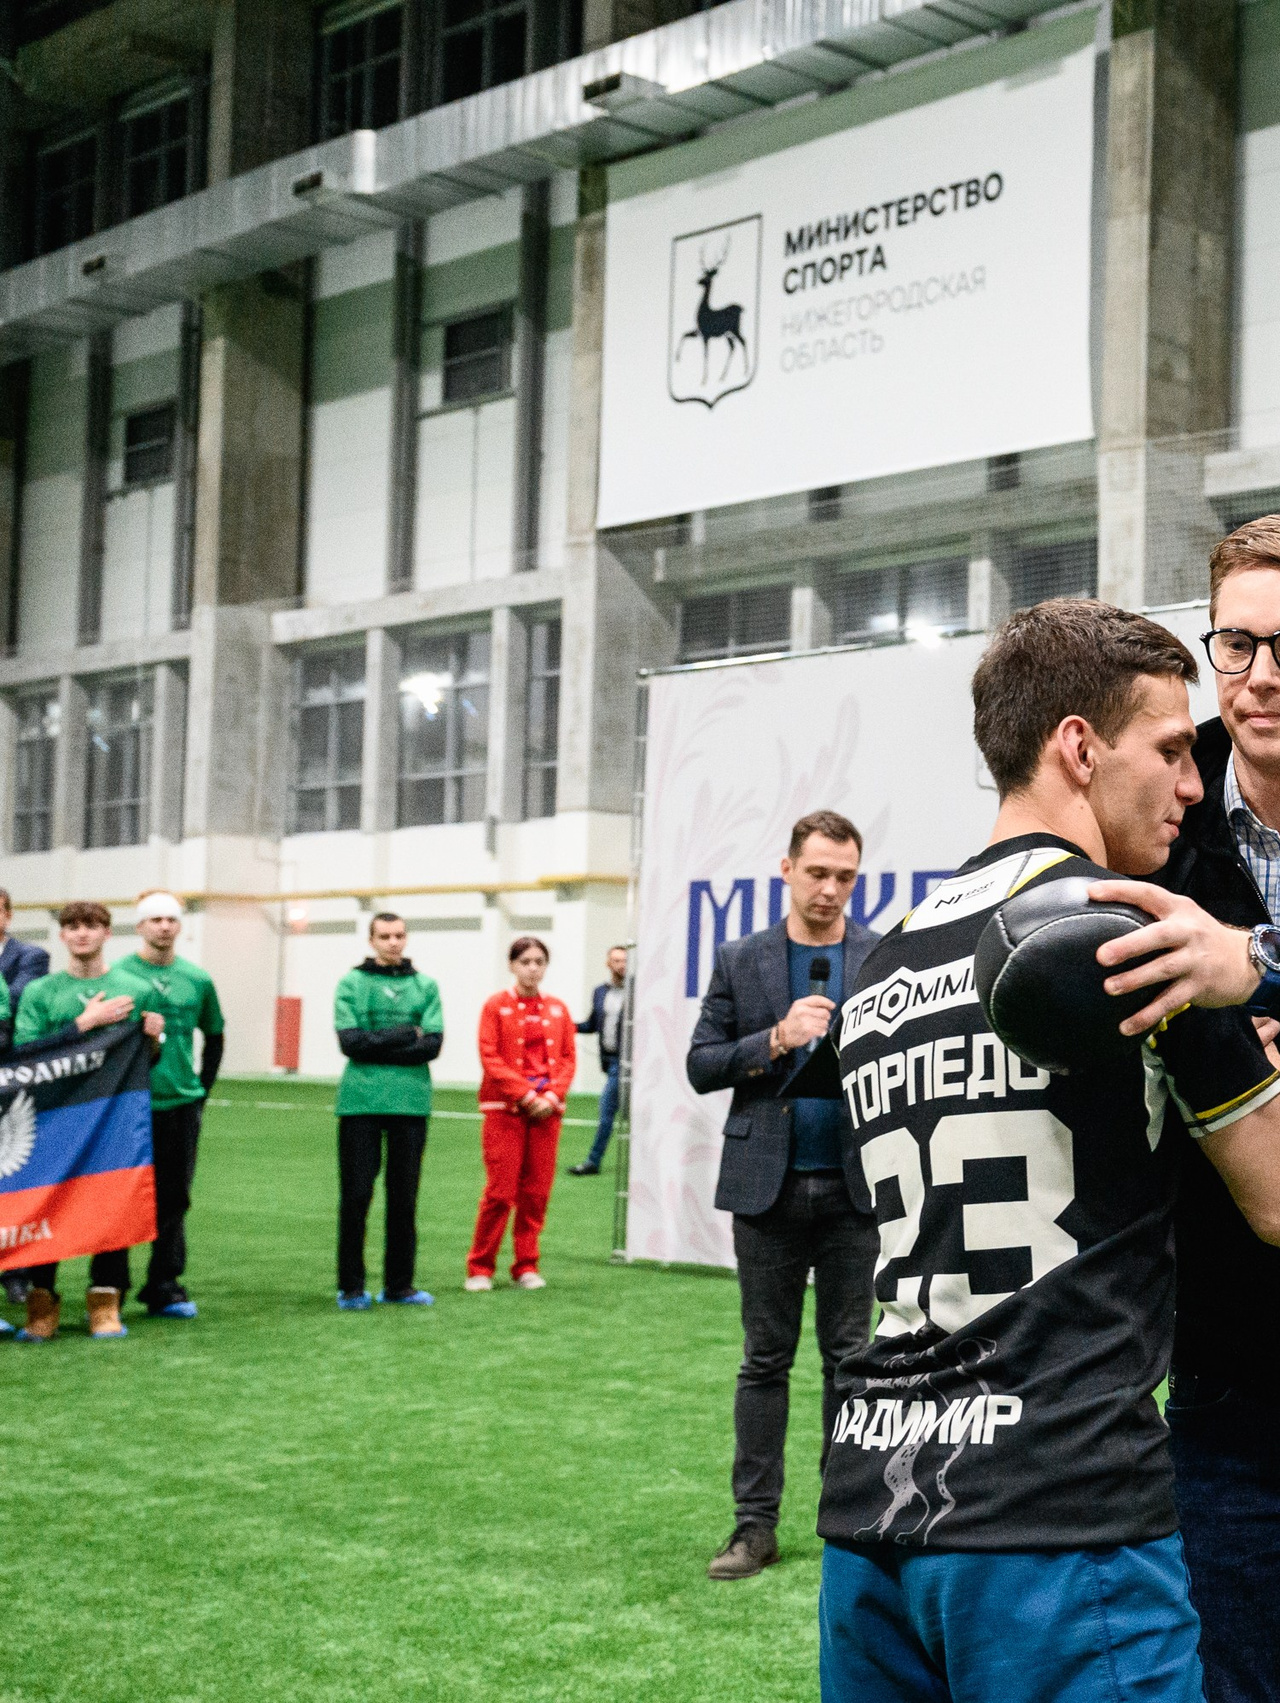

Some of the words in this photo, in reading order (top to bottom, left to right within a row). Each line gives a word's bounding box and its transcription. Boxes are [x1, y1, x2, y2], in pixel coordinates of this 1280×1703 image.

[784, 171, 1003, 257] МИНИСТЕРСТВО
[783, 244, 887, 294] СПОРТА
[780, 265, 986, 337] НИЖЕГОРОДСКАЯ
[780, 328, 885, 373] ОБЛАСТЬ
[844, 967, 975, 1035] ПРОММ
[0, 1050, 106, 1086] РОДНАЯ
[860, 1110, 1079, 1337] 23
[832, 1395, 1023, 1451] ЛАДИМИР
